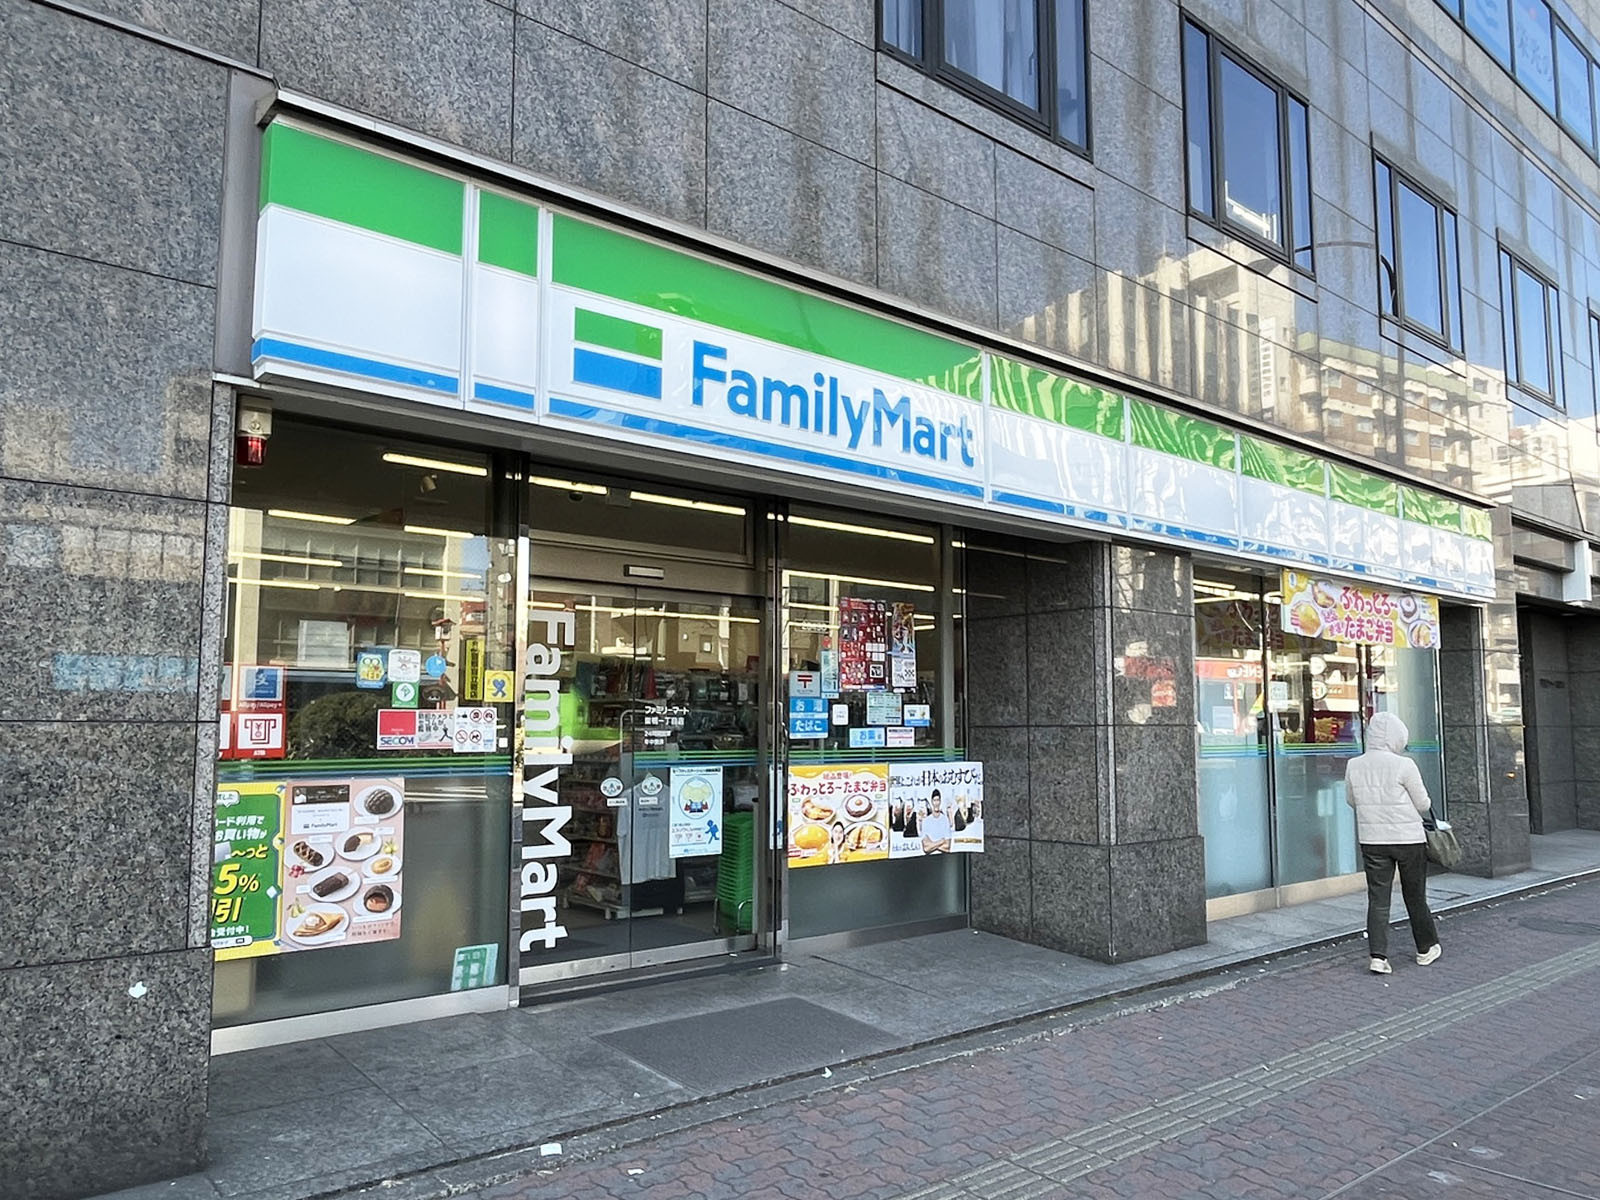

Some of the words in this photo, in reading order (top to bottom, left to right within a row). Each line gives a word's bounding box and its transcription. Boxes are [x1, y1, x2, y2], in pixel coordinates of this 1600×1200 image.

[692, 339, 975, 468] FamilyMart
[1344, 615, 1394, 643] たまご弁当
[644, 705, 690, 715] ファミリーマート
[380, 736, 414, 745] SECOM
[518, 610, 575, 952] FamilyMart
